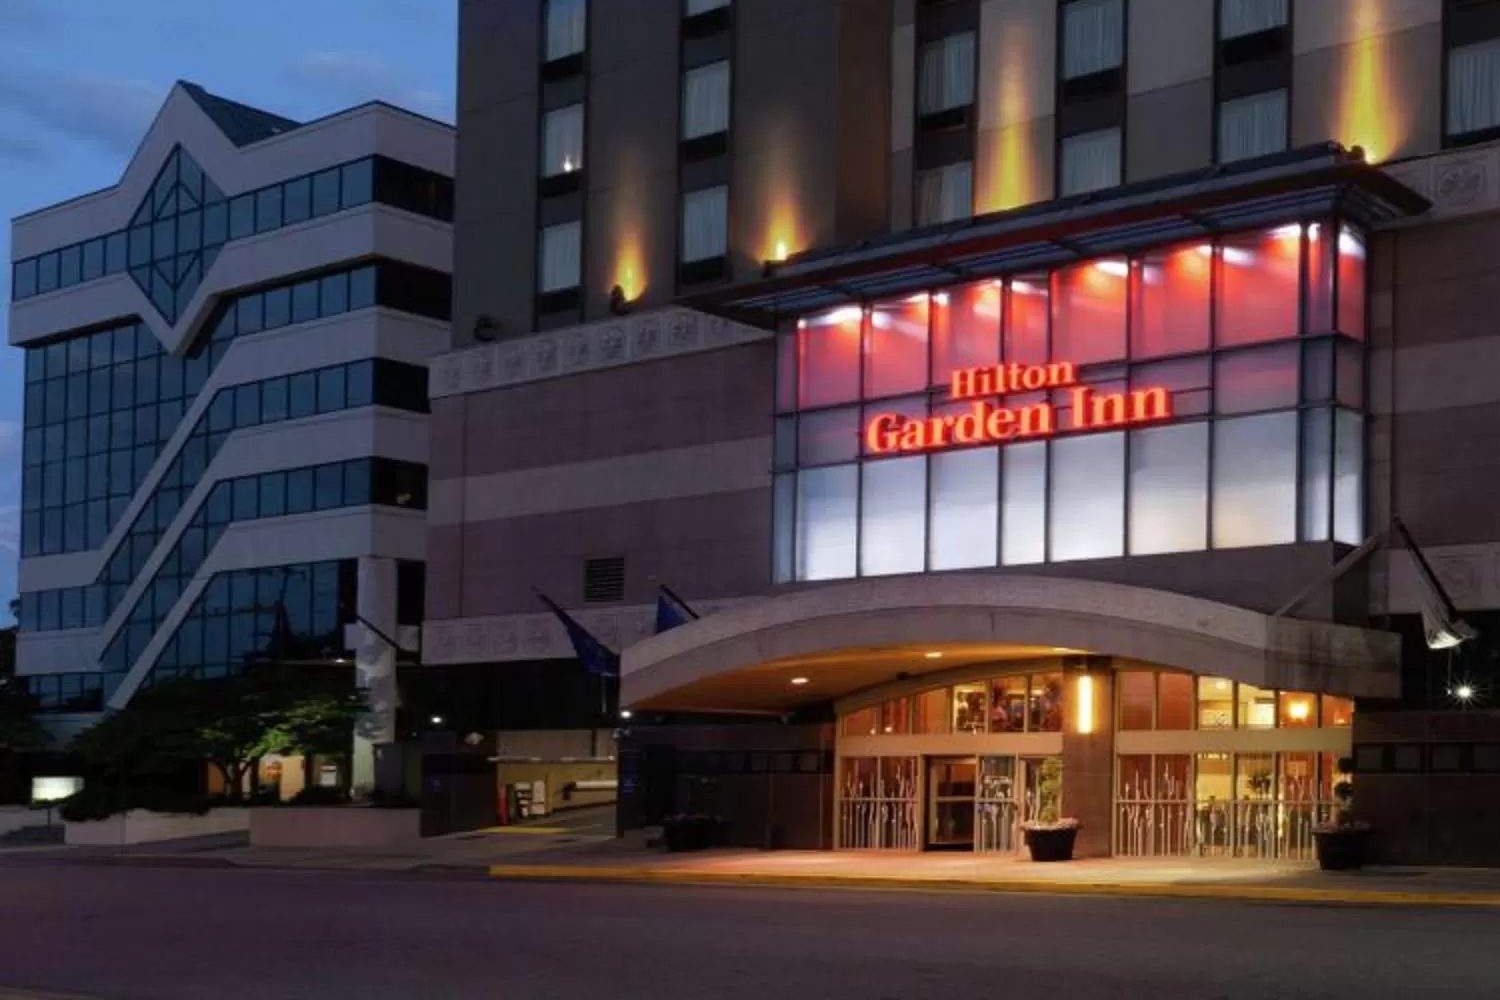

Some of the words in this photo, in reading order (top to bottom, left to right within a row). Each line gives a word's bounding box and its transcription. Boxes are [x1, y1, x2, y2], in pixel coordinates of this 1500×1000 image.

[951, 360, 1077, 399] Hilton
[866, 400, 1055, 453] Garden
[1070, 385, 1171, 429] Inn
